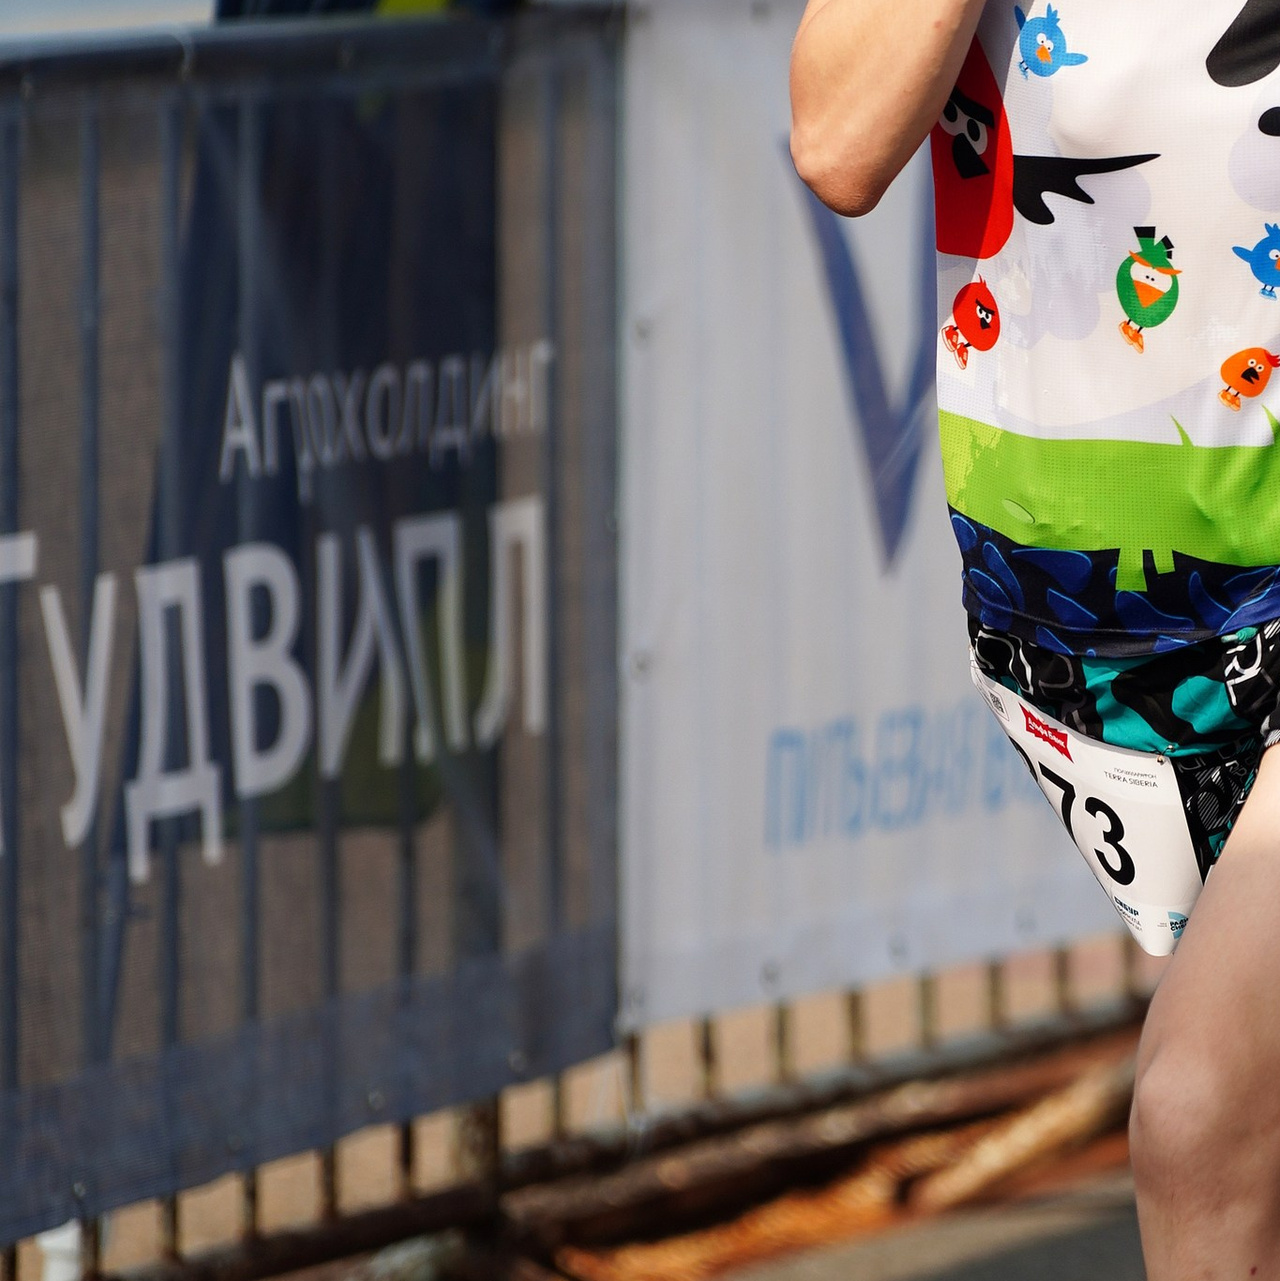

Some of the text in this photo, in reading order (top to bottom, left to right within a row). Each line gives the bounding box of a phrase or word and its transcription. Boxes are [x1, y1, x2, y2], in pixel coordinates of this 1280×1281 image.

[218, 340, 553, 502] Агрохолдинг
[1008, 735, 1135, 886] 73
[1104, 771, 1159, 789] TERRA SIBERIA
